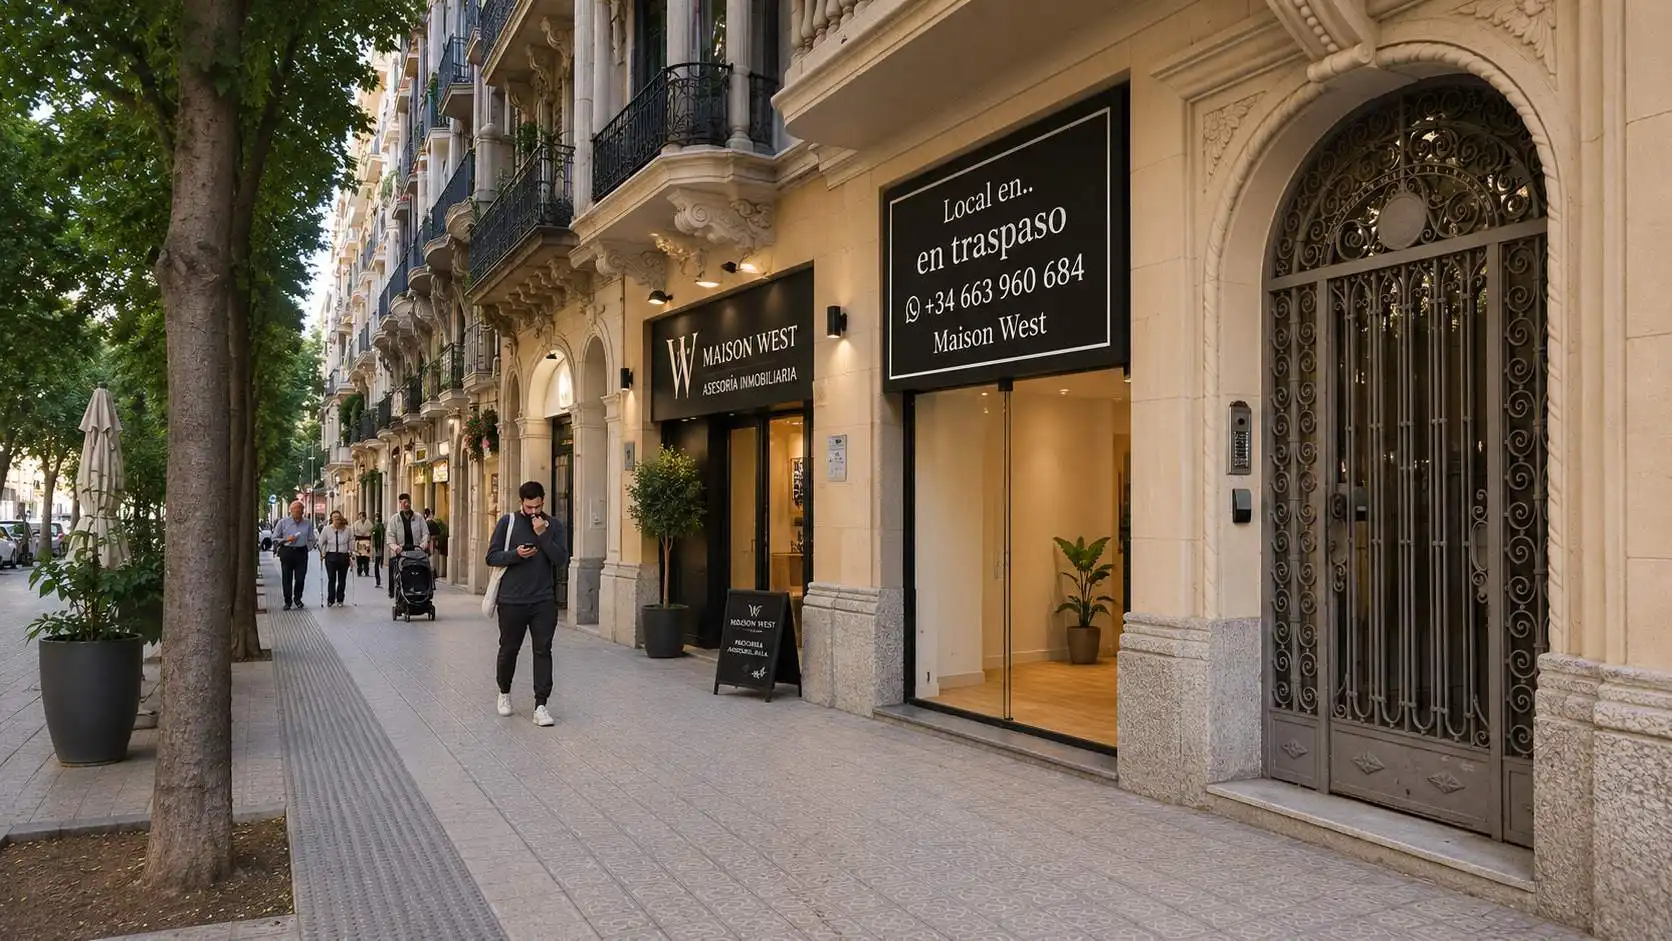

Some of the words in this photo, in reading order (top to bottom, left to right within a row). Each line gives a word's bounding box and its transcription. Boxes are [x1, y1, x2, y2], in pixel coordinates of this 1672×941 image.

[943, 182, 991, 223] Local
[998, 177, 1033, 203] en..
[916, 246, 944, 275] en
[951, 206, 1067, 264] traspaso
[925, 288, 955, 315] +34
[960, 278, 993, 308] 663
[999, 267, 1036, 299] 960
[1043, 253, 1084, 288] 684
[703, 337, 752, 367] MAISON
[757, 325, 797, 354] WEST
[934, 326, 994, 354] Maison
[999, 311, 1047, 341] West
[702, 374, 738, 396] ASESORÍA
[740, 367, 797, 390] INMOBILIARIA
